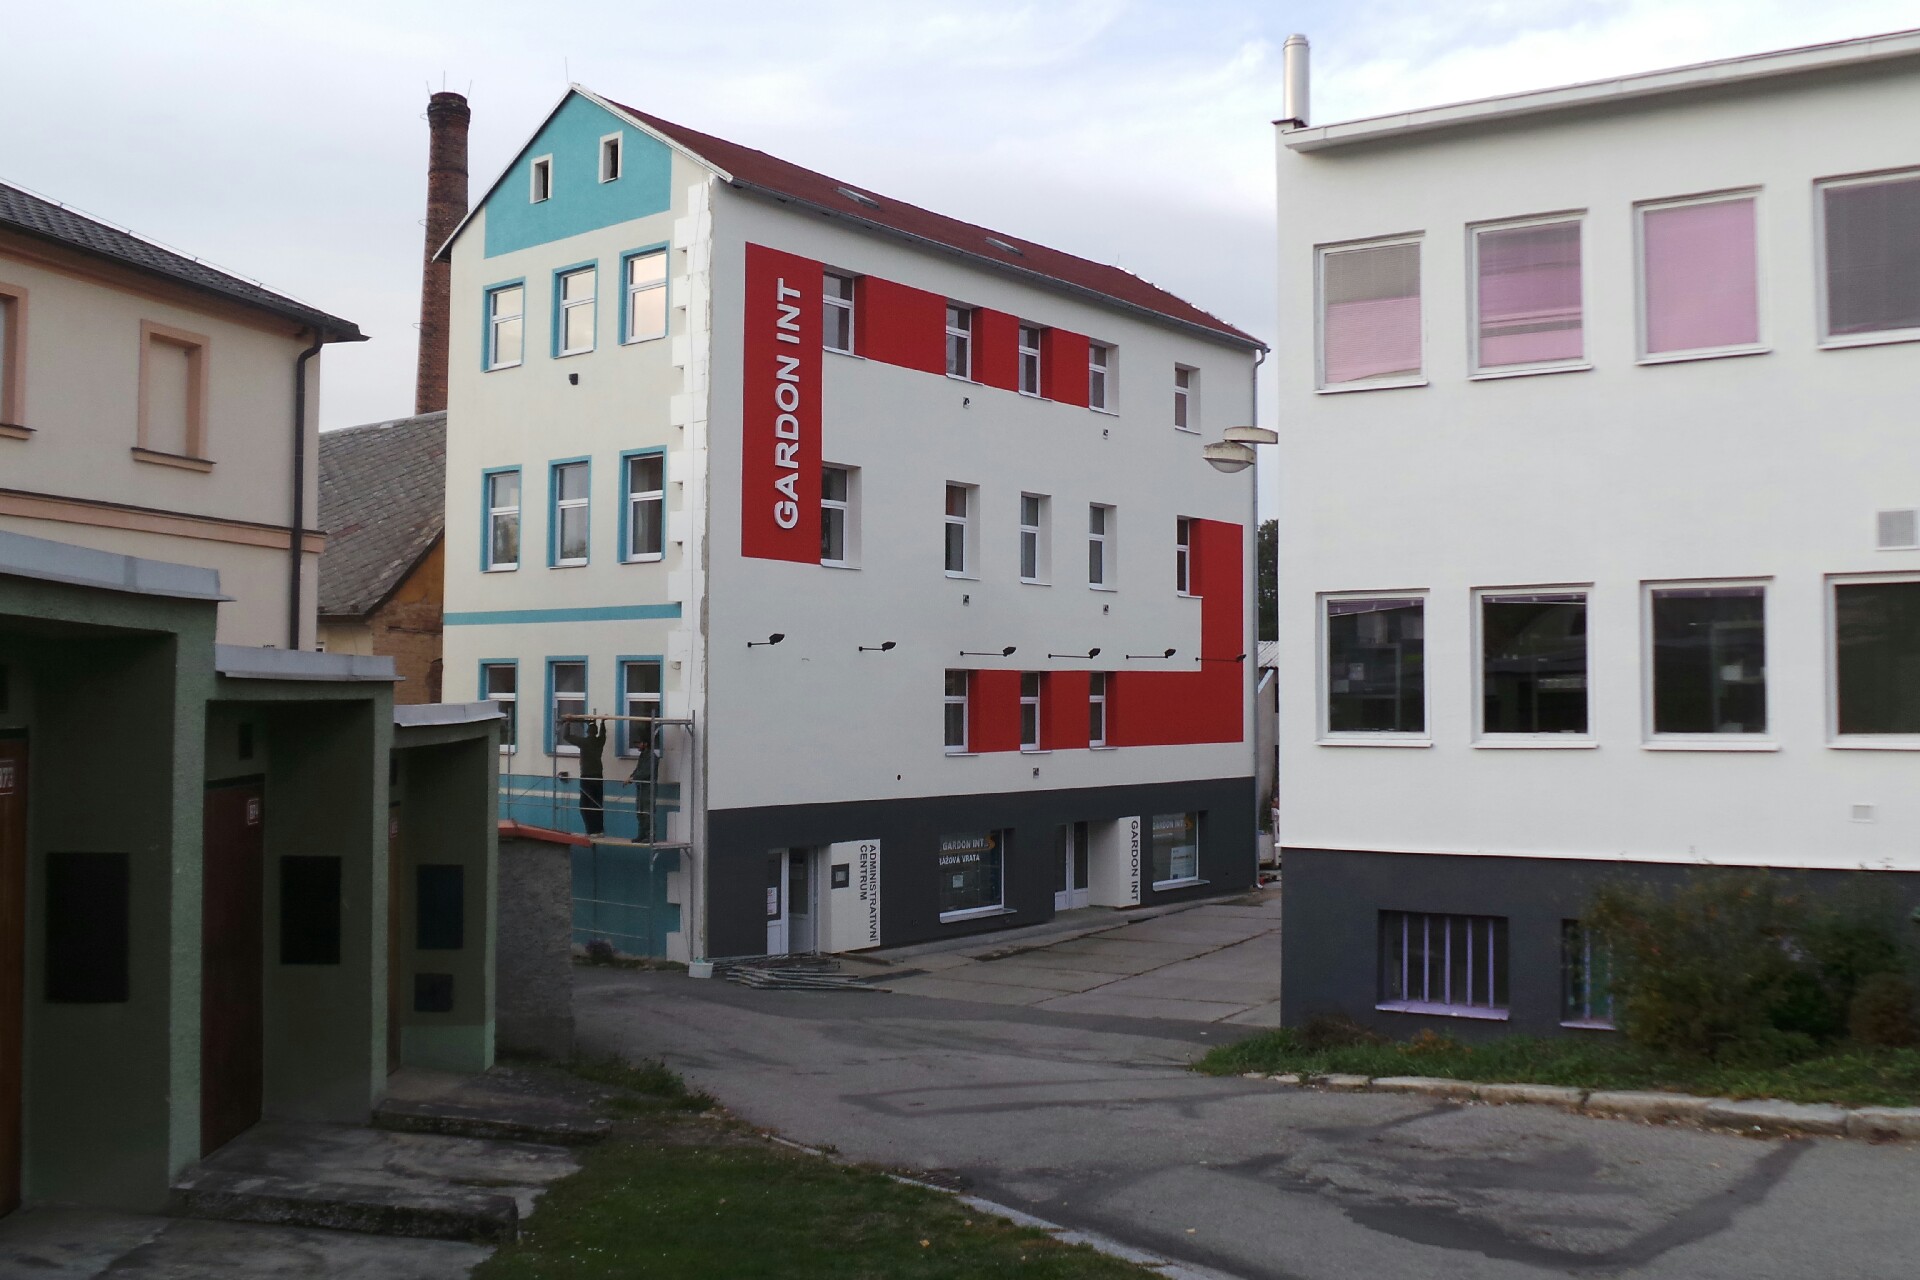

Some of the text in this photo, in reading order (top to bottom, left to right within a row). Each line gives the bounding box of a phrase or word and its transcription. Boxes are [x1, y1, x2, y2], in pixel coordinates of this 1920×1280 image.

[774, 277, 801, 529] GARDON INT
[860, 844, 868, 901] CENTRUM
[942, 840, 971, 851] GARDON
[962, 854, 980, 862] VRATA
[1131, 820, 1139, 901] GARDON INT
[869, 844, 878, 942] ADMINISTRATIVNÍ
